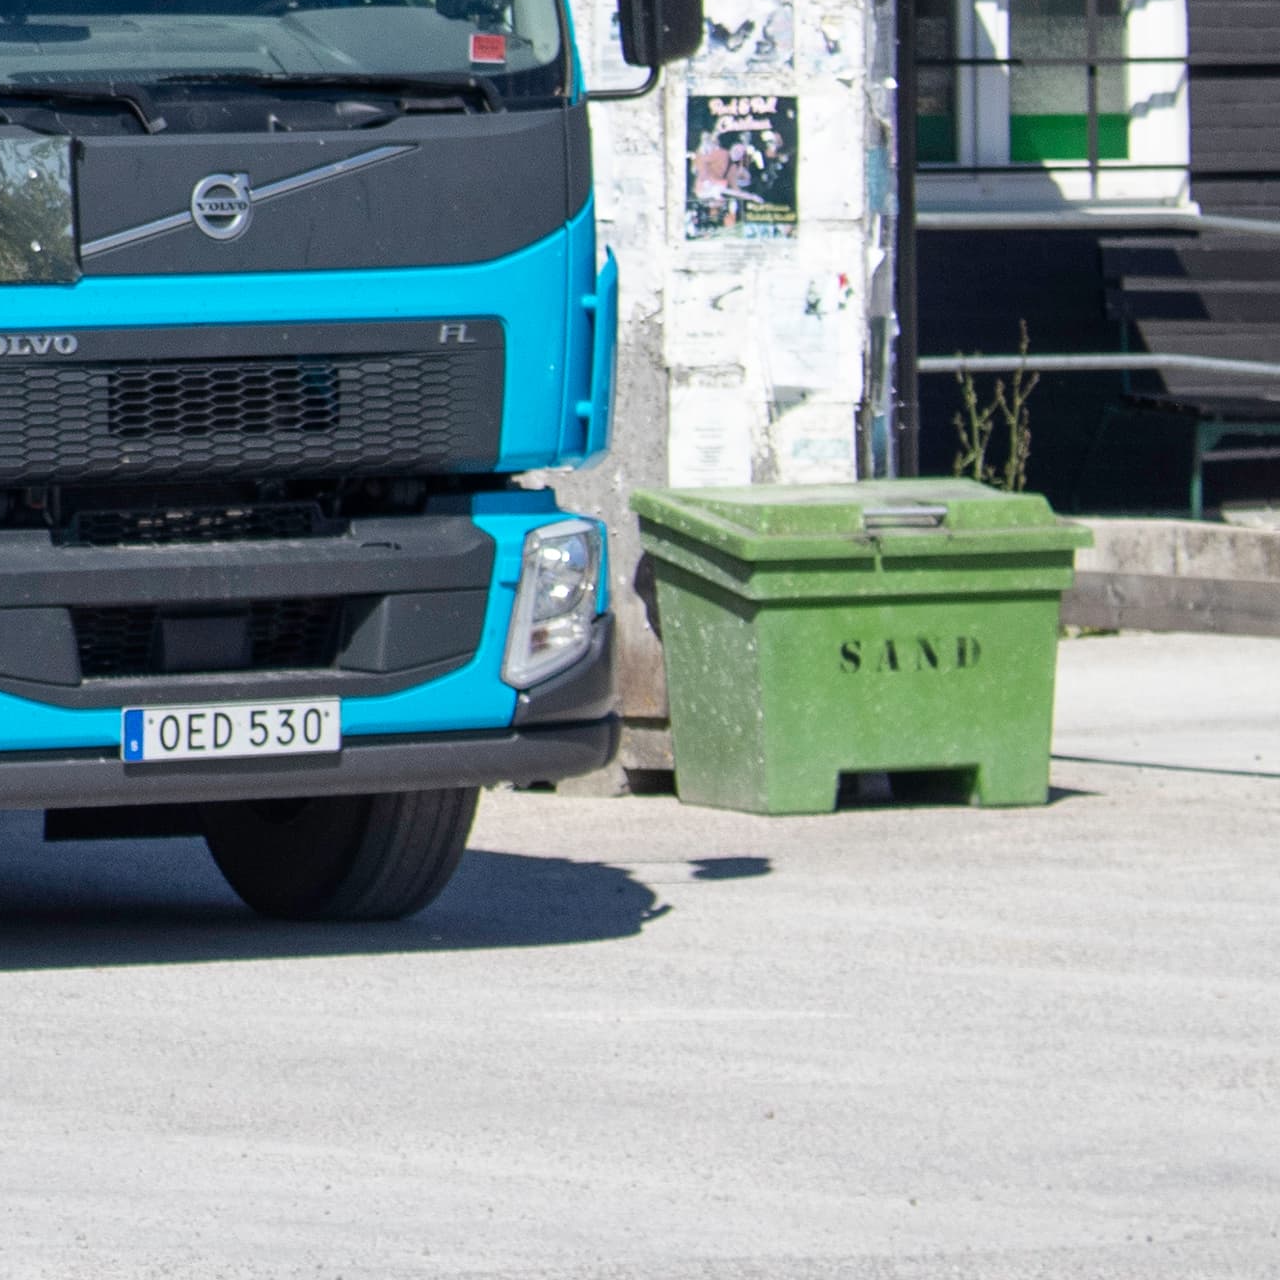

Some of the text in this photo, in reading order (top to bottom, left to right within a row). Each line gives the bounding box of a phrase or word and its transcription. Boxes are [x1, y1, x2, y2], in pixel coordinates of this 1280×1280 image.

[196, 201, 248, 211] VOLVO
[440, 323, 477, 344] FL
[839, 635, 982, 673] SAND
[159, 707, 323, 752] OED 530
[130, 740, 139, 752] S
